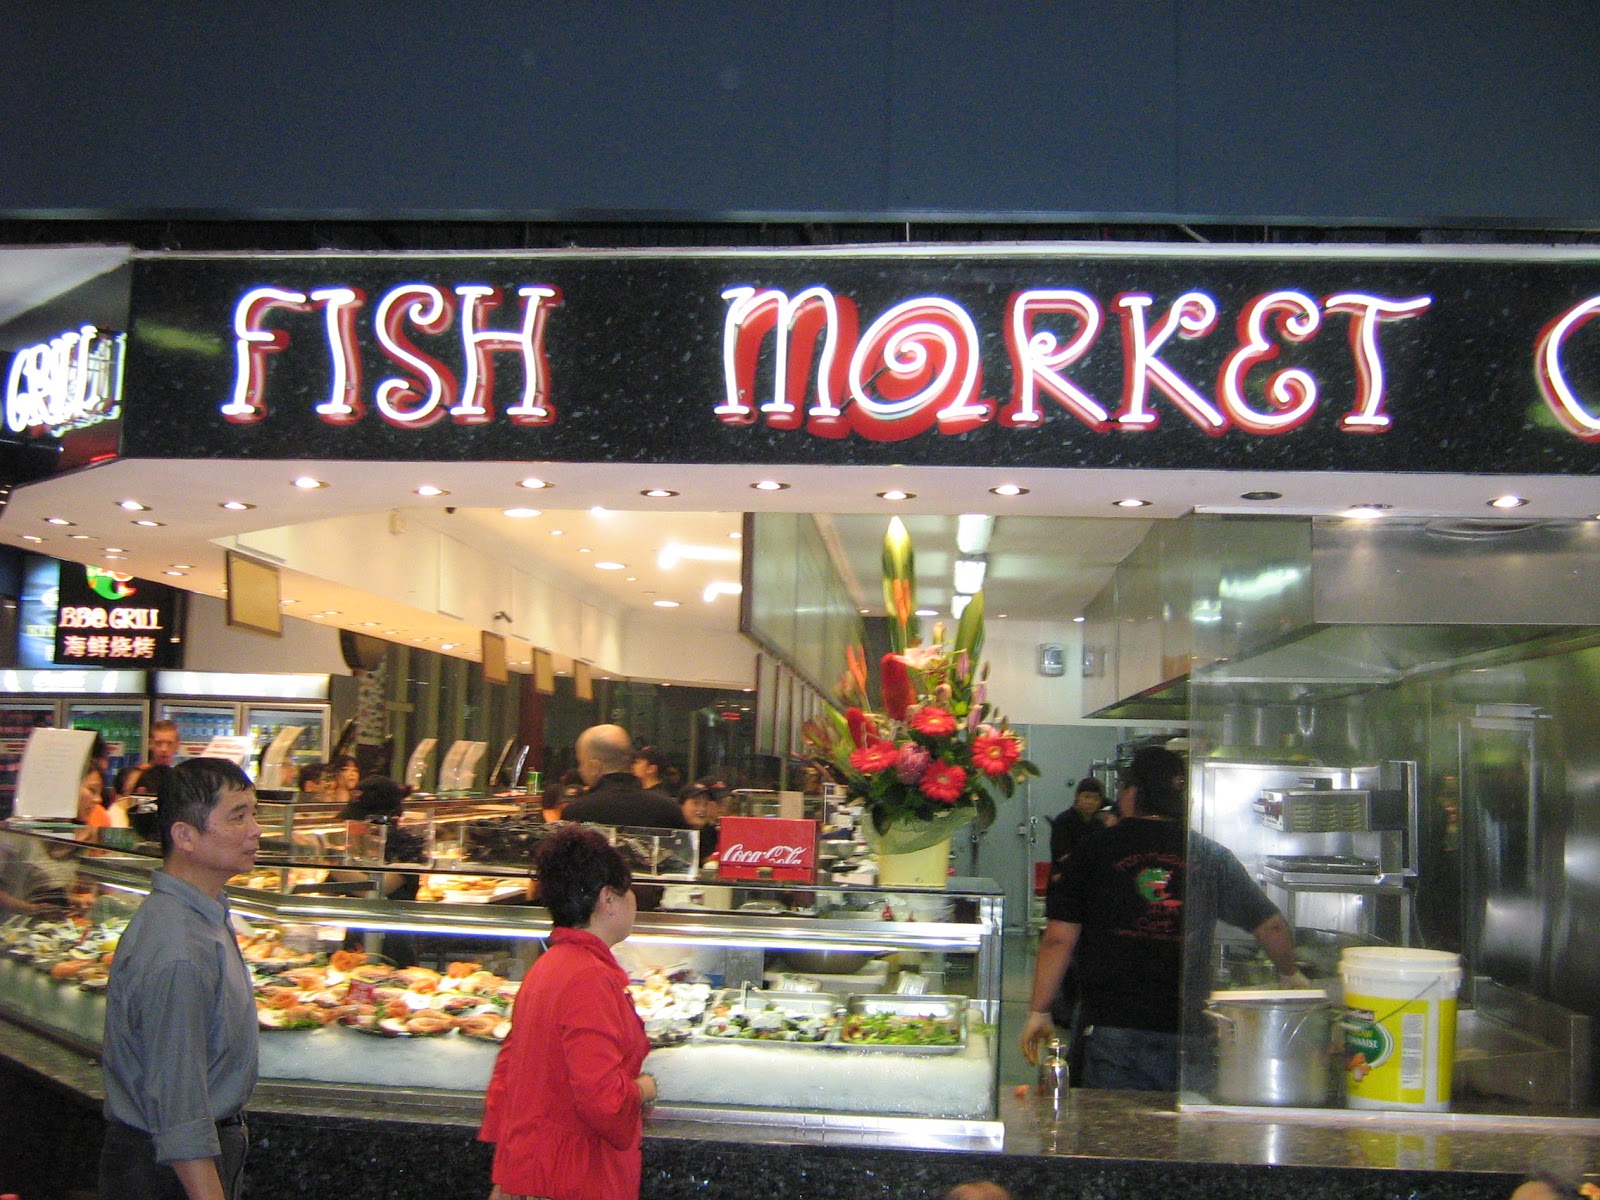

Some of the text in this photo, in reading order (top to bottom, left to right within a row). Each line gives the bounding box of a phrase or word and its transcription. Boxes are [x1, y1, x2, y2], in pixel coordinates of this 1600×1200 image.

[220, 283, 562, 428] FISH
[58, 606, 164, 630] BBQ GRILL
[722, 844, 807, 864] Coca-Cola
